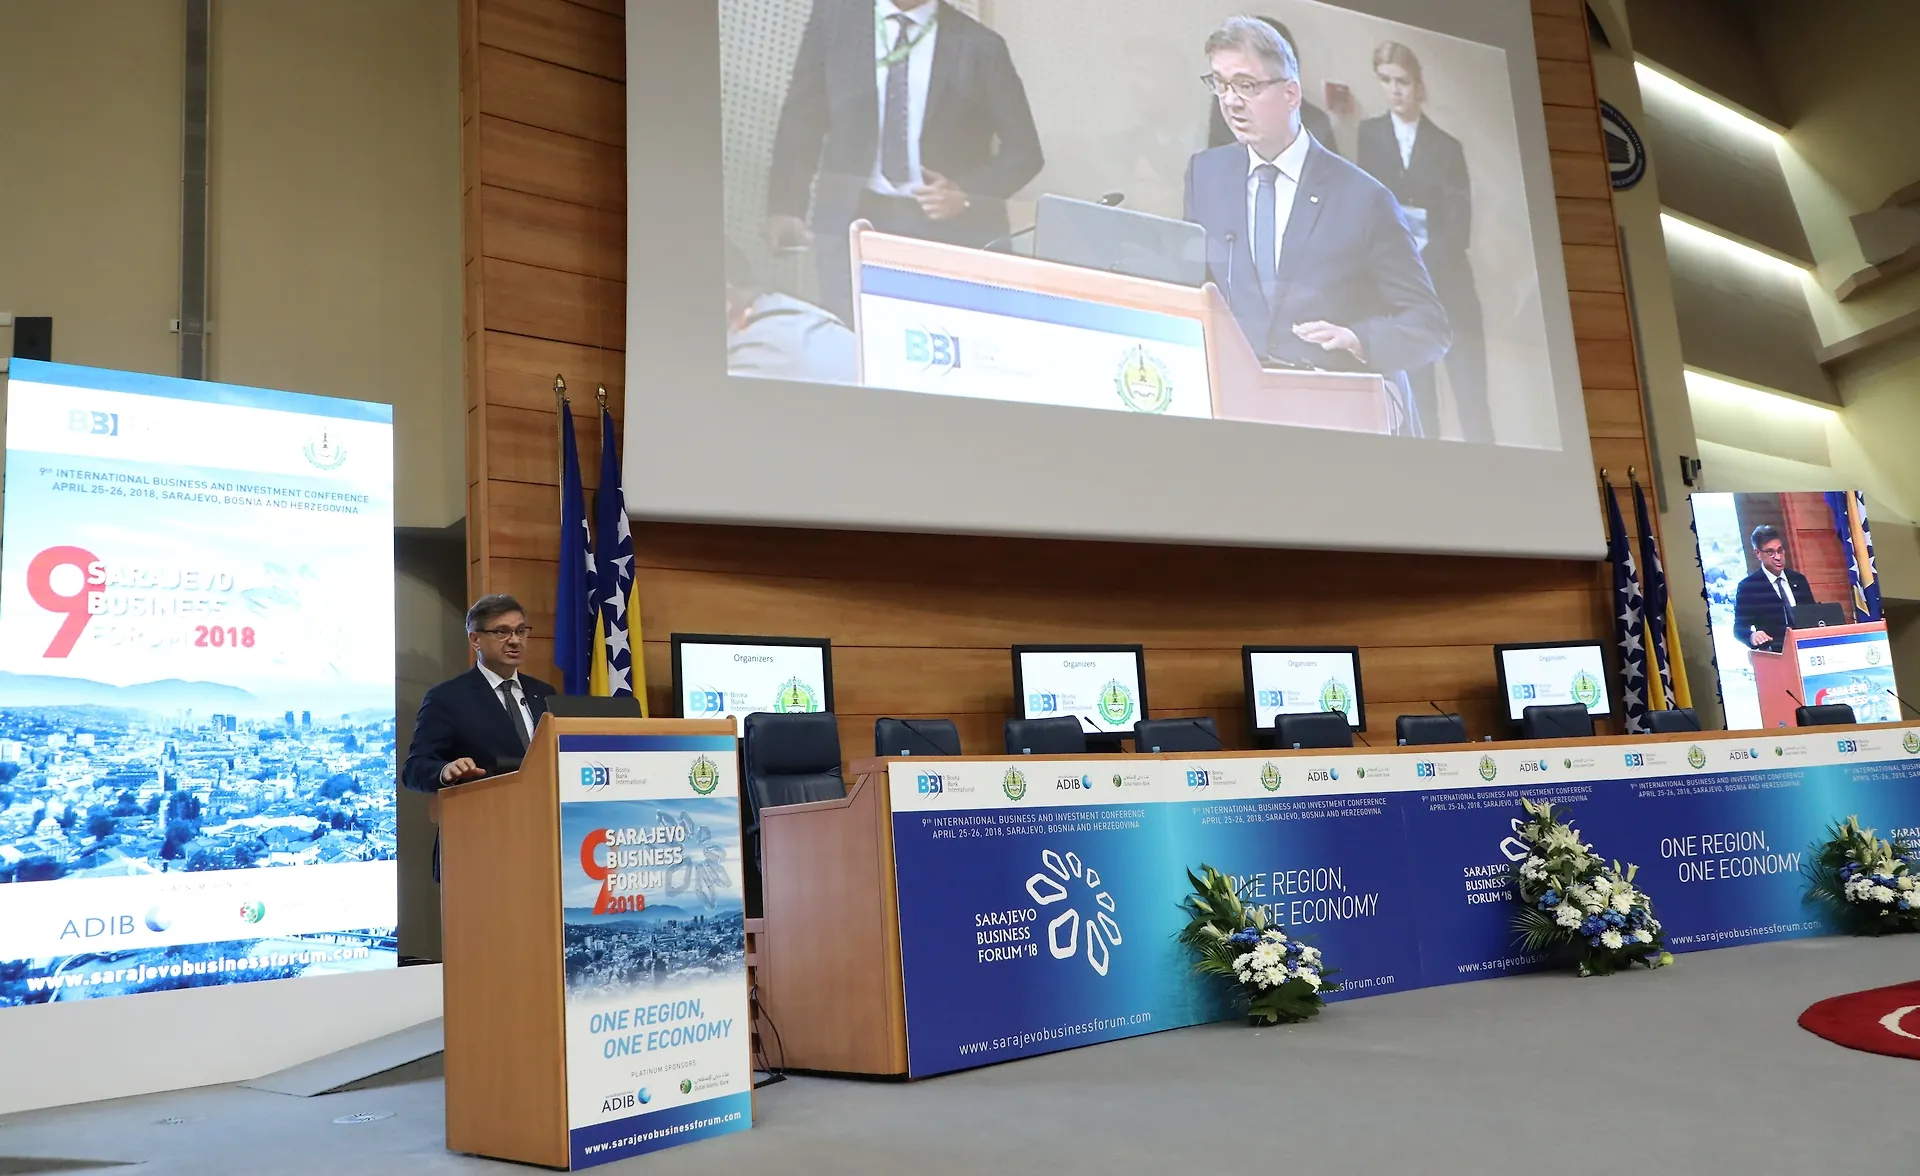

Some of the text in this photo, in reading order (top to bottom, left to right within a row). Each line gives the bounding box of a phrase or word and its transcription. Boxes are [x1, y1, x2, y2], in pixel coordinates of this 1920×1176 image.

[56, 468, 150, 485] INTERNATIONAL
[153, 477, 207, 489] BUSINESS
[211, 482, 233, 492] AND
[236, 484, 301, 497] INVESTMENT
[304, 490, 369, 503] CONFERENCE
[52, 482, 359, 514] APRIL 25-26, 2018, SARAJEVO, BOSNIA AND HERZEGOVINA
[27, 546, 106, 658] 9
[195, 626, 255, 648] 2018
[734, 654, 773, 664] Organizers
[1064, 660, 1096, 669] Organizers
[1259, 690, 1284, 706] BBI
[1512, 684, 1536, 699] BBI
[690, 692, 724, 712] BBI
[1029, 694, 1057, 711] BBI
[1730, 752, 1749, 760] ADIB
[1837, 741, 1857, 753] BBI
[1520, 762, 1539, 772] ADIB
[1625, 754, 1644, 767] BBI
[581, 767, 610, 786] BBI
[1187, 771, 1209, 787] BBI
[1308, 772, 1329, 782] ADIB
[1417, 763, 1436, 777] BBI
[918, 776, 943, 793] BBI
[1056, 779, 1081, 790] ADIB
[1639, 781, 1685, 789] INTERNATIONAL
[1687, 778, 1716, 787] BUSINESS
[1731, 775, 1766, 783] INVESTMENT
[1768, 772, 1805, 780] CONFERENCE
[1726, 784, 1747, 792] BOSNIA
[1762, 780, 1801, 789] HERZEGOVINA
[1430, 794, 1476, 802] INTERNATIONAL
[1477, 791, 1506, 799] BUSINESS
[1520, 788, 1555, 797] INVESTMENT
[1556, 786, 1592, 795] CONFERENCE
[1448, 803, 1466, 811] 25-26,
[1550, 795, 1588, 803] HERZEGOVINA
[1203, 805, 1256, 815] INTERNATIONAL
[1258, 803, 1291, 812] BUSINESS
[1293, 802, 1306, 810] AND
[1308, 800, 1346, 809] INVESTMENT
[1348, 798, 1387, 807] CONFERENCE
[922, 809, 1145, 827] 9th INTERNATIONAL BUSINESS AND INVESTMENT CONFERENCE
[1202, 817, 1222, 825] APRIL
[1224, 816, 1245, 824] 25-26,
[1302, 811, 1325, 819] BOSNIA
[1327, 810, 1340, 818] AND
[1341, 808, 1382, 817] HERZEGOVINA
[605, 826, 685, 847] SARAJEVO
[932, 821, 1140, 839] APRIL 25-26, 2018, SARAJEVO, BOSNIA AND HERZEGOVINA
[1661, 830, 1770, 859] ONE REGION,
[606, 847, 683, 869] BUSINESS
[1464, 864, 1510, 878] SARAJEVO
[1678, 852, 1801, 883] ONE ECONOMY
[607, 871, 663, 891] FORUM
[1272, 867, 1347, 896] REGION,
[1466, 877, 1506, 891] BUSINESS
[608, 894, 645, 914] 2018
[1467, 892, 1501, 905] FORUM
[975, 908, 1038, 927] SARAJEVO
[1291, 893, 1379, 926] ECONOMY
[60, 916, 135, 940] ADIB
[977, 927, 1031, 945] BUSINESS
[1671, 919, 1822, 945] www.sarajevobusinessforum.com
[978, 946, 1023, 964] FORUM
[27, 945, 369, 991] www.sarajevobusinessforum.com
[590, 998, 705, 1034] ONE REGION,
[604, 1018, 733, 1059] ONE ECONOMY
[959, 1011, 1152, 1056] www.sarajevobusinessforum.com
[631, 1060, 697, 1078] PLATINUM SPONSORS
[602, 1094, 635, 1113] ADIB
[585, 1111, 741, 1155] www.sarajevobusinessforum.com
